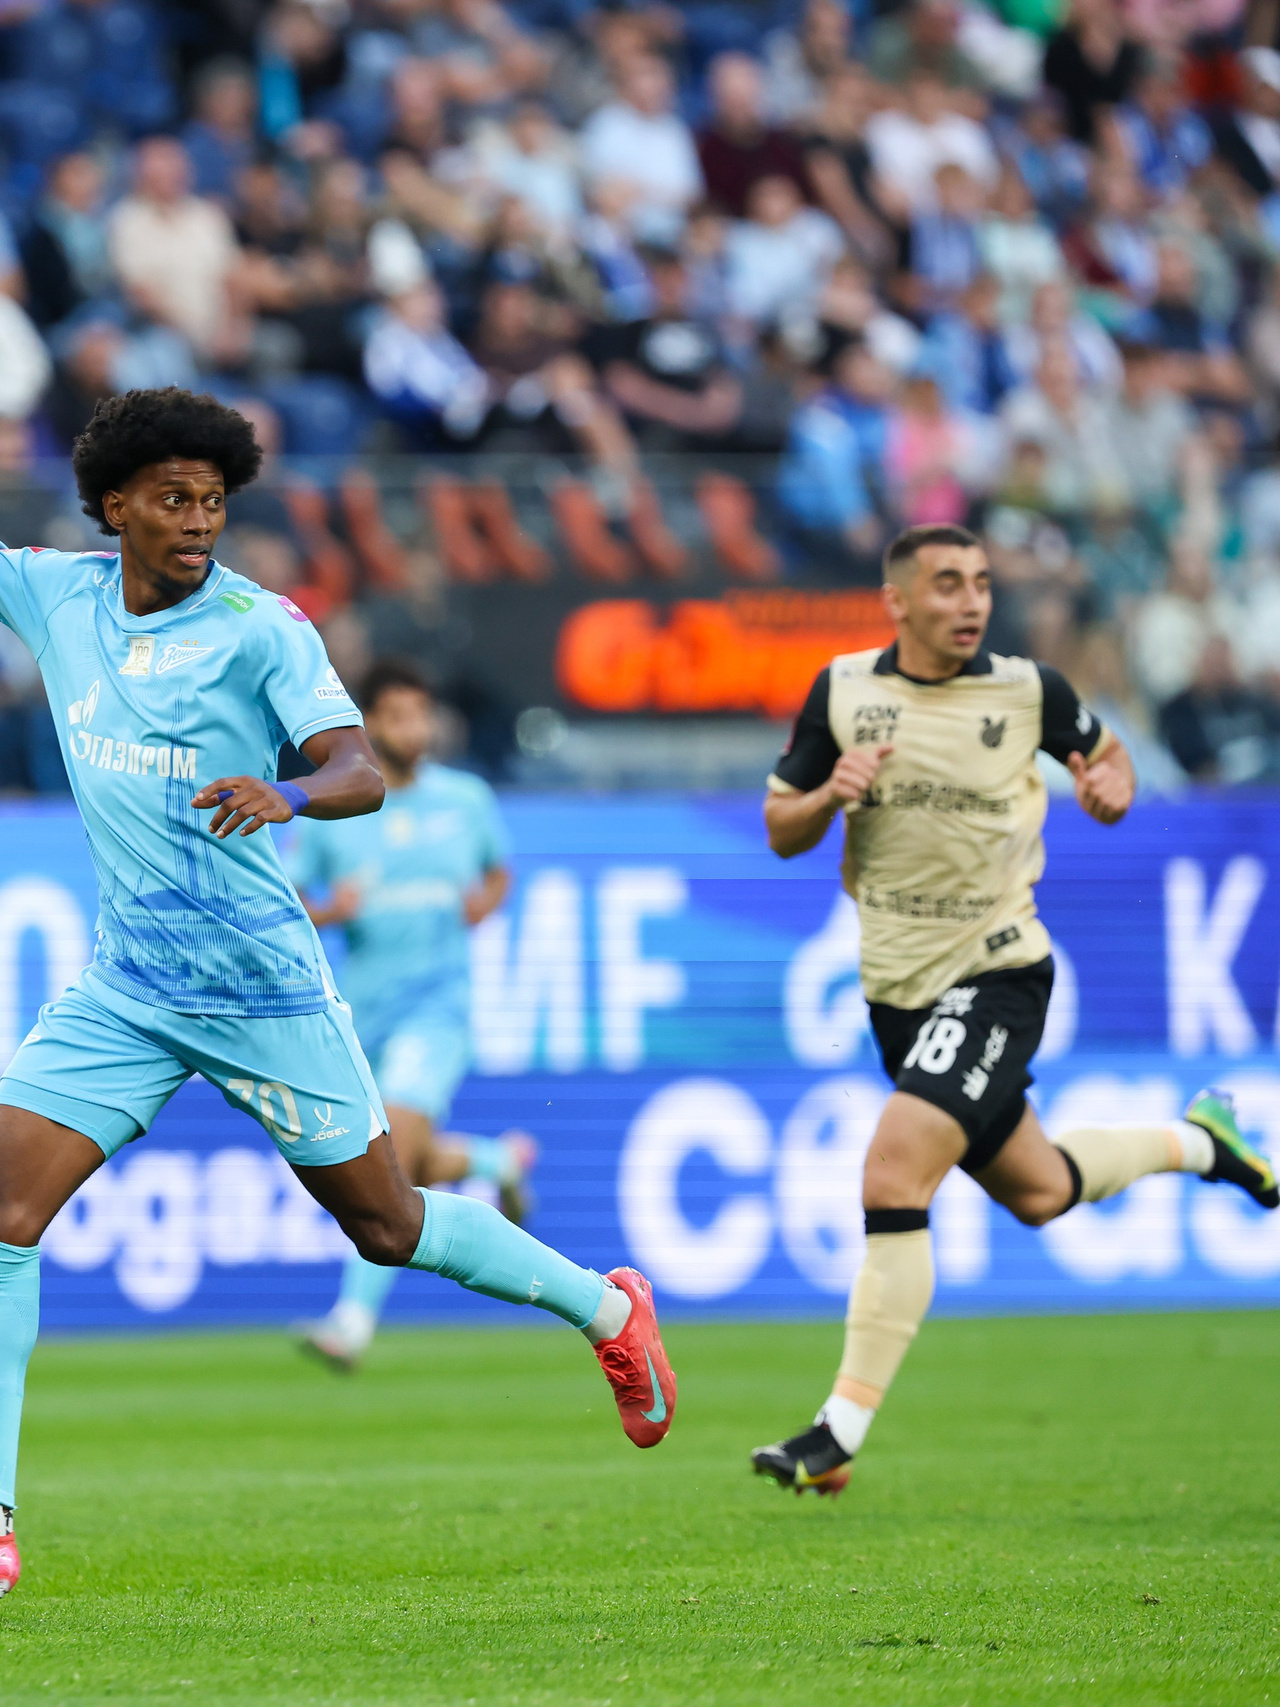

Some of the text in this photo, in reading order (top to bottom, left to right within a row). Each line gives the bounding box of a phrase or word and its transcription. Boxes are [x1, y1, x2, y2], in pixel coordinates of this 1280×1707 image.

[89, 734, 197, 779] ГАЗПРОМ
[903, 1016, 967, 1075] 18
[310, 1126, 350, 1142] JÖGEL
